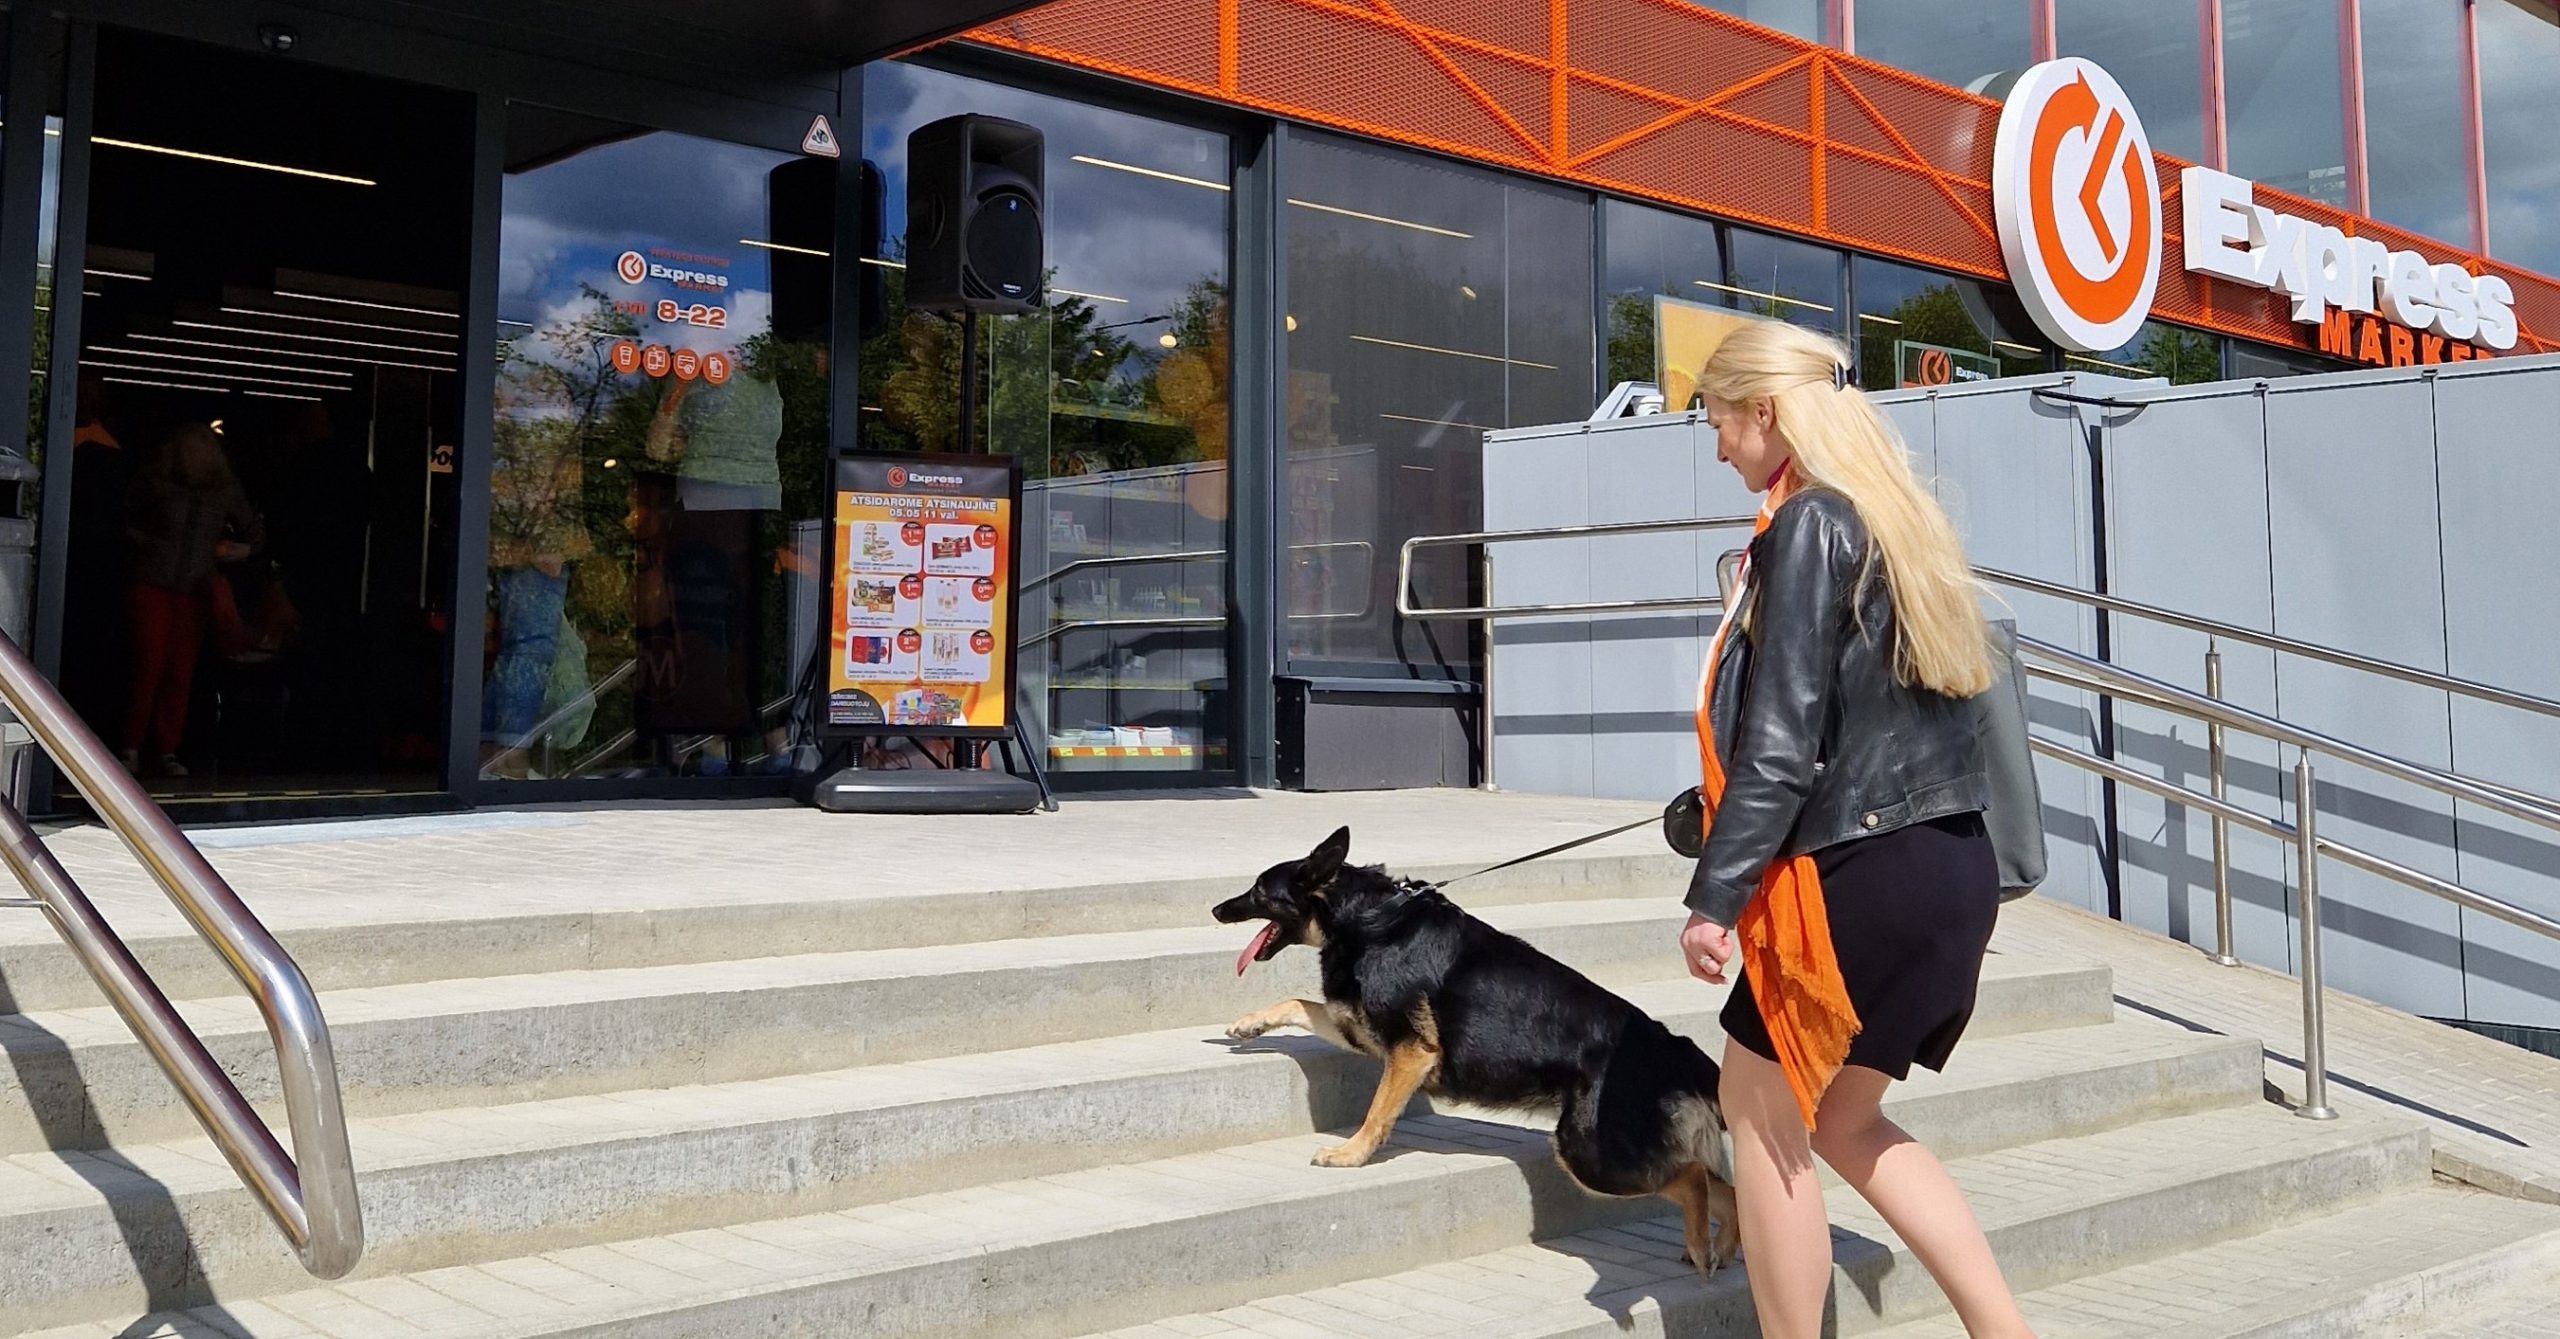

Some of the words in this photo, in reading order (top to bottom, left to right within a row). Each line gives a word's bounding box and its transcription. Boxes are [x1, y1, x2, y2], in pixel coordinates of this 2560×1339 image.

[2182, 166, 2518, 349] Express
[650, 264, 729, 287] Express
[909, 472, 963, 484] Express
[850, 495, 923, 508] ATSIDAROME
[926, 498, 997, 512] ATSINAUJINĘ
[889, 508, 920, 518] 05.05
[924, 510, 936, 519] 11
[940, 511, 959, 520] val.
